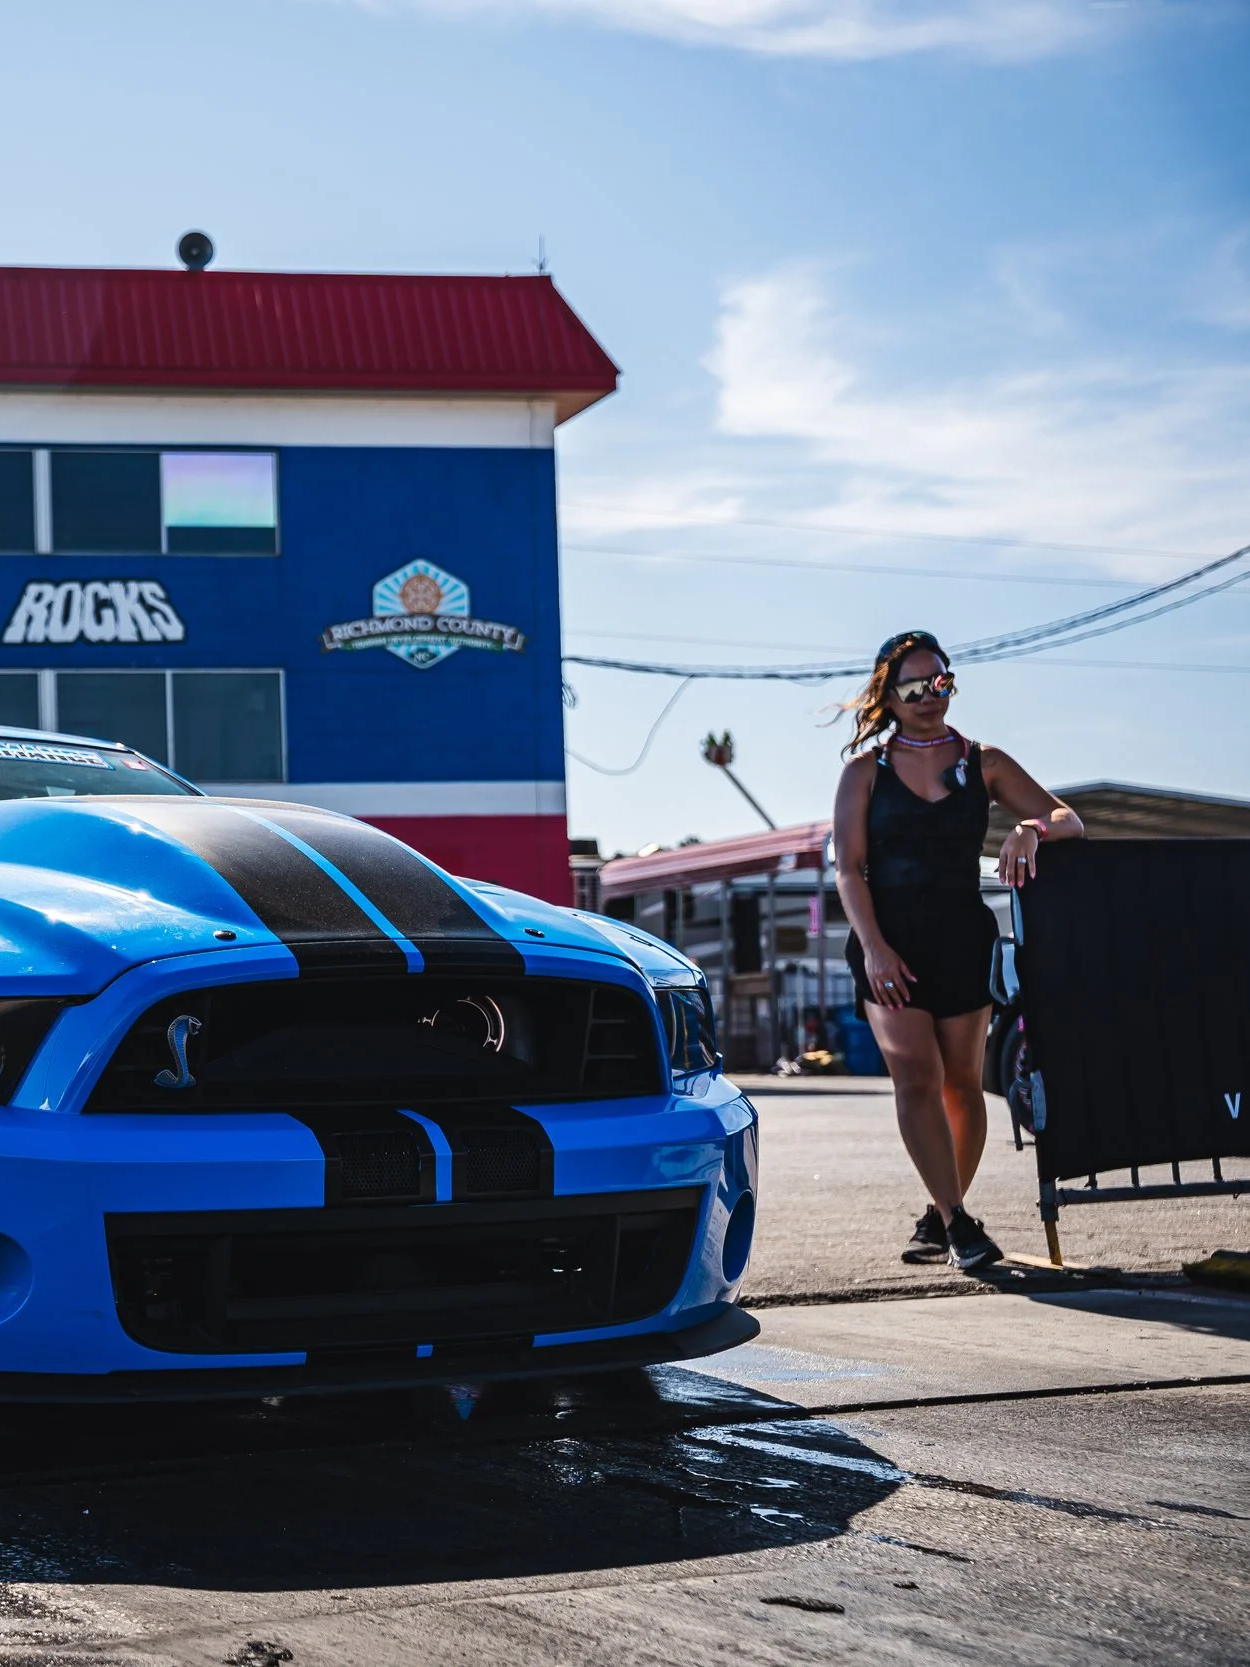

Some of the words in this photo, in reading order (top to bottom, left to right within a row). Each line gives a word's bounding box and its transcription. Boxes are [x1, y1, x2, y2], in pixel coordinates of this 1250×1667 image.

[1, 581, 185, 643] ROCKS
[331, 615, 431, 640] RICHMOND
[436, 616, 518, 643] COUNTY
